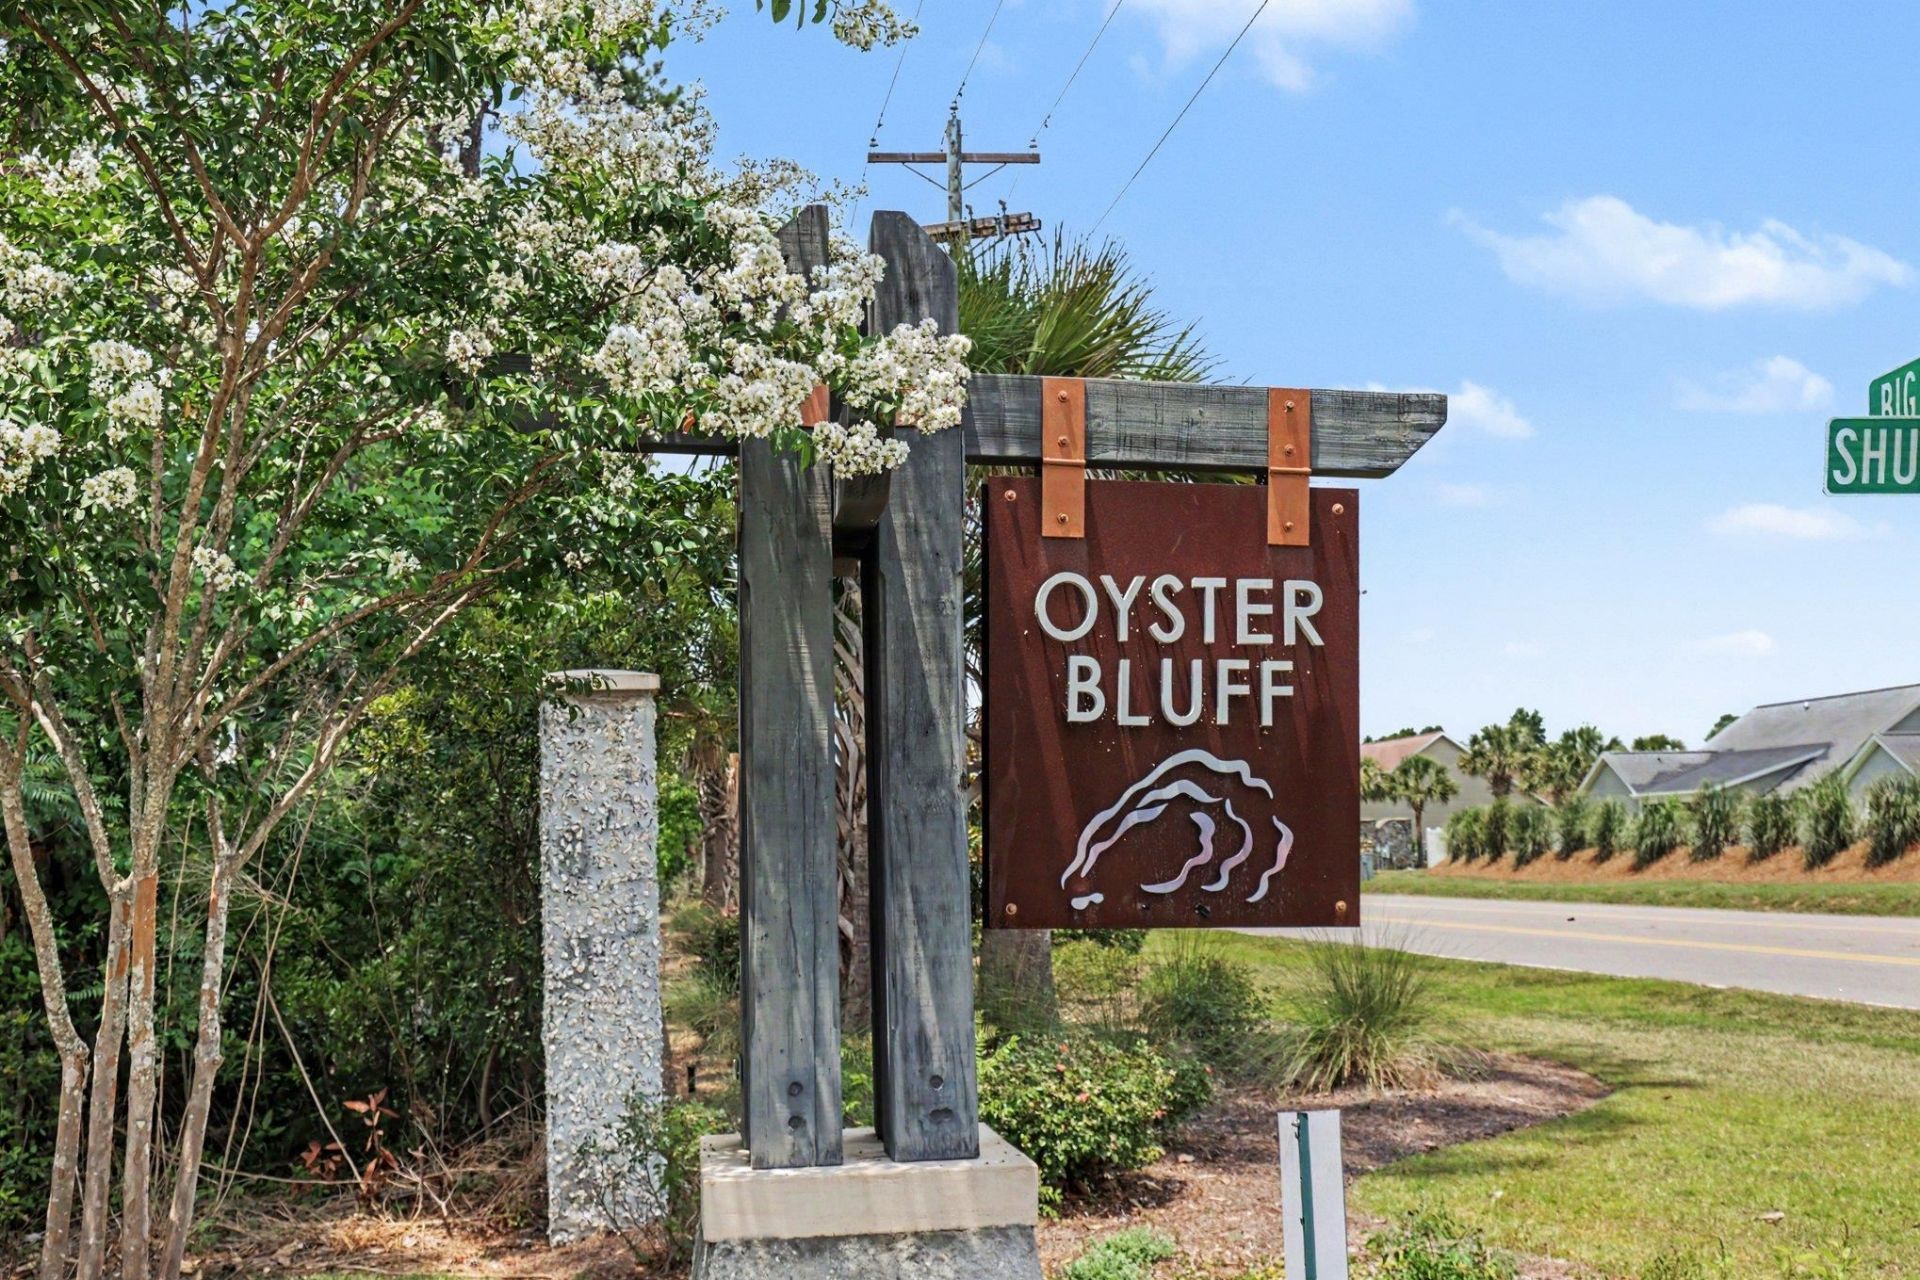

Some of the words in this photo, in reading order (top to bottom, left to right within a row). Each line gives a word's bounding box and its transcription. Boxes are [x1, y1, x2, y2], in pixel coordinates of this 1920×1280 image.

[1881, 371, 1916, 417] BIG
[1832, 427, 1919, 485] SHU
[1034, 571, 1325, 646] OYSTER
[1067, 655, 1294, 726] BLUFF
